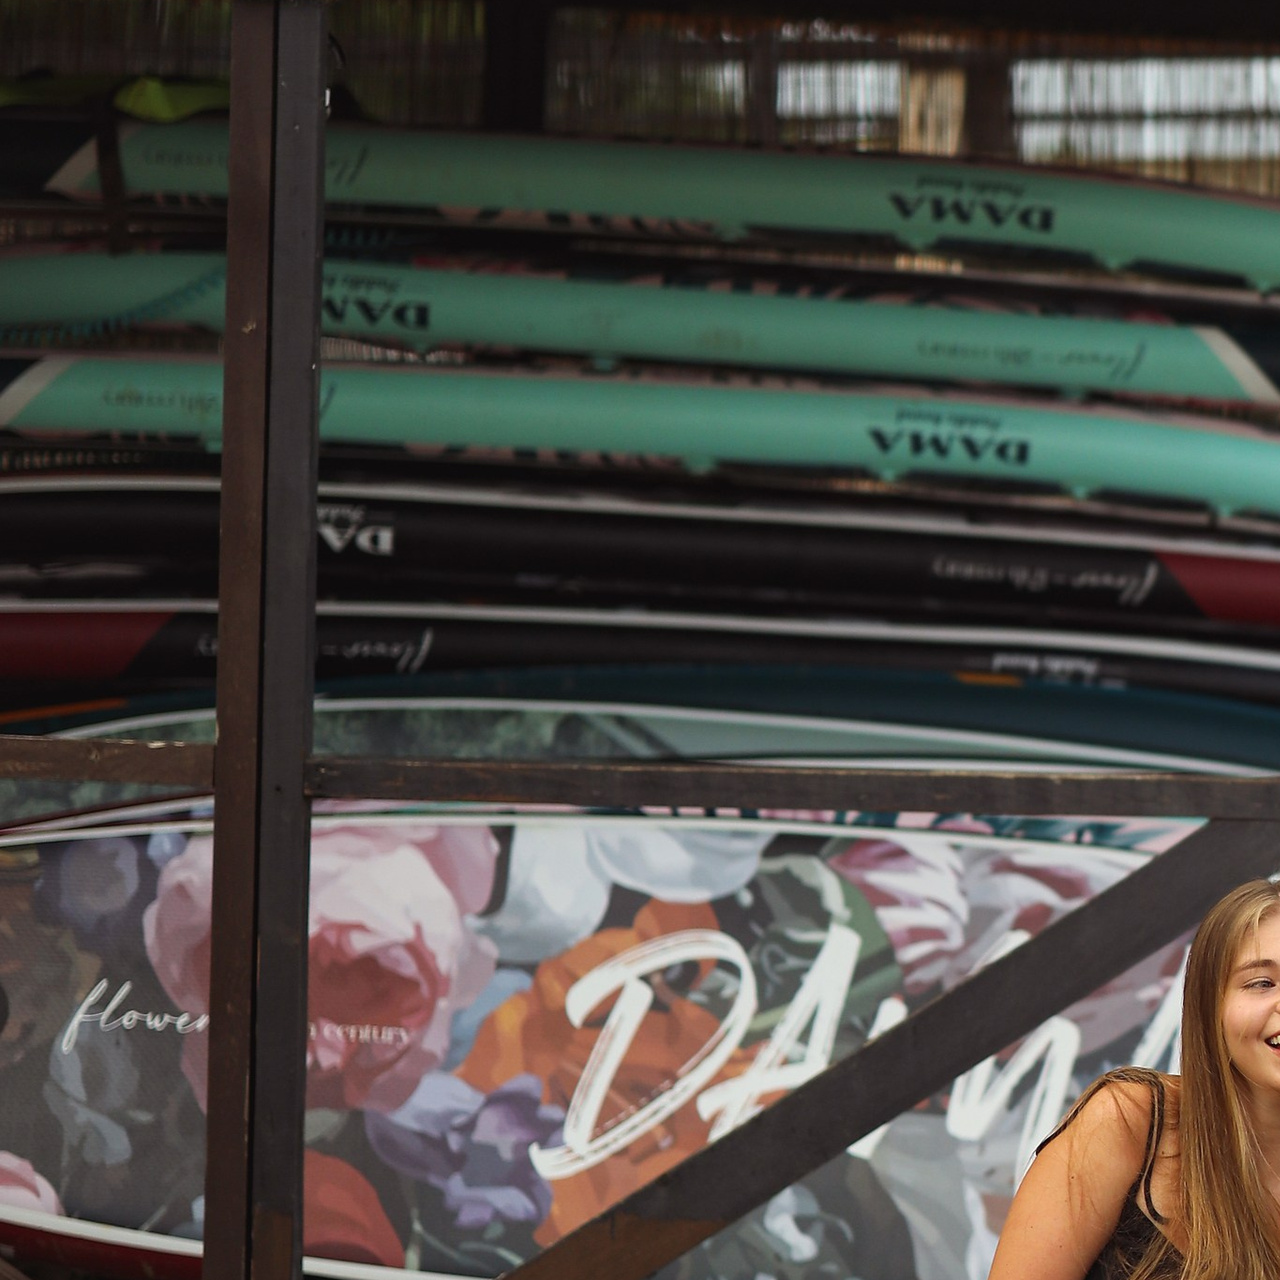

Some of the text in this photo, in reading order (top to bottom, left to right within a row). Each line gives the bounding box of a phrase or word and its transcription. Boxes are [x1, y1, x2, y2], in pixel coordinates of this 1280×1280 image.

[888, 192, 1055, 234] DAMA
[322, 295, 430, 331] DAM
[868, 429, 1030, 467] DAMA
[323, 1023, 409, 1050] century
